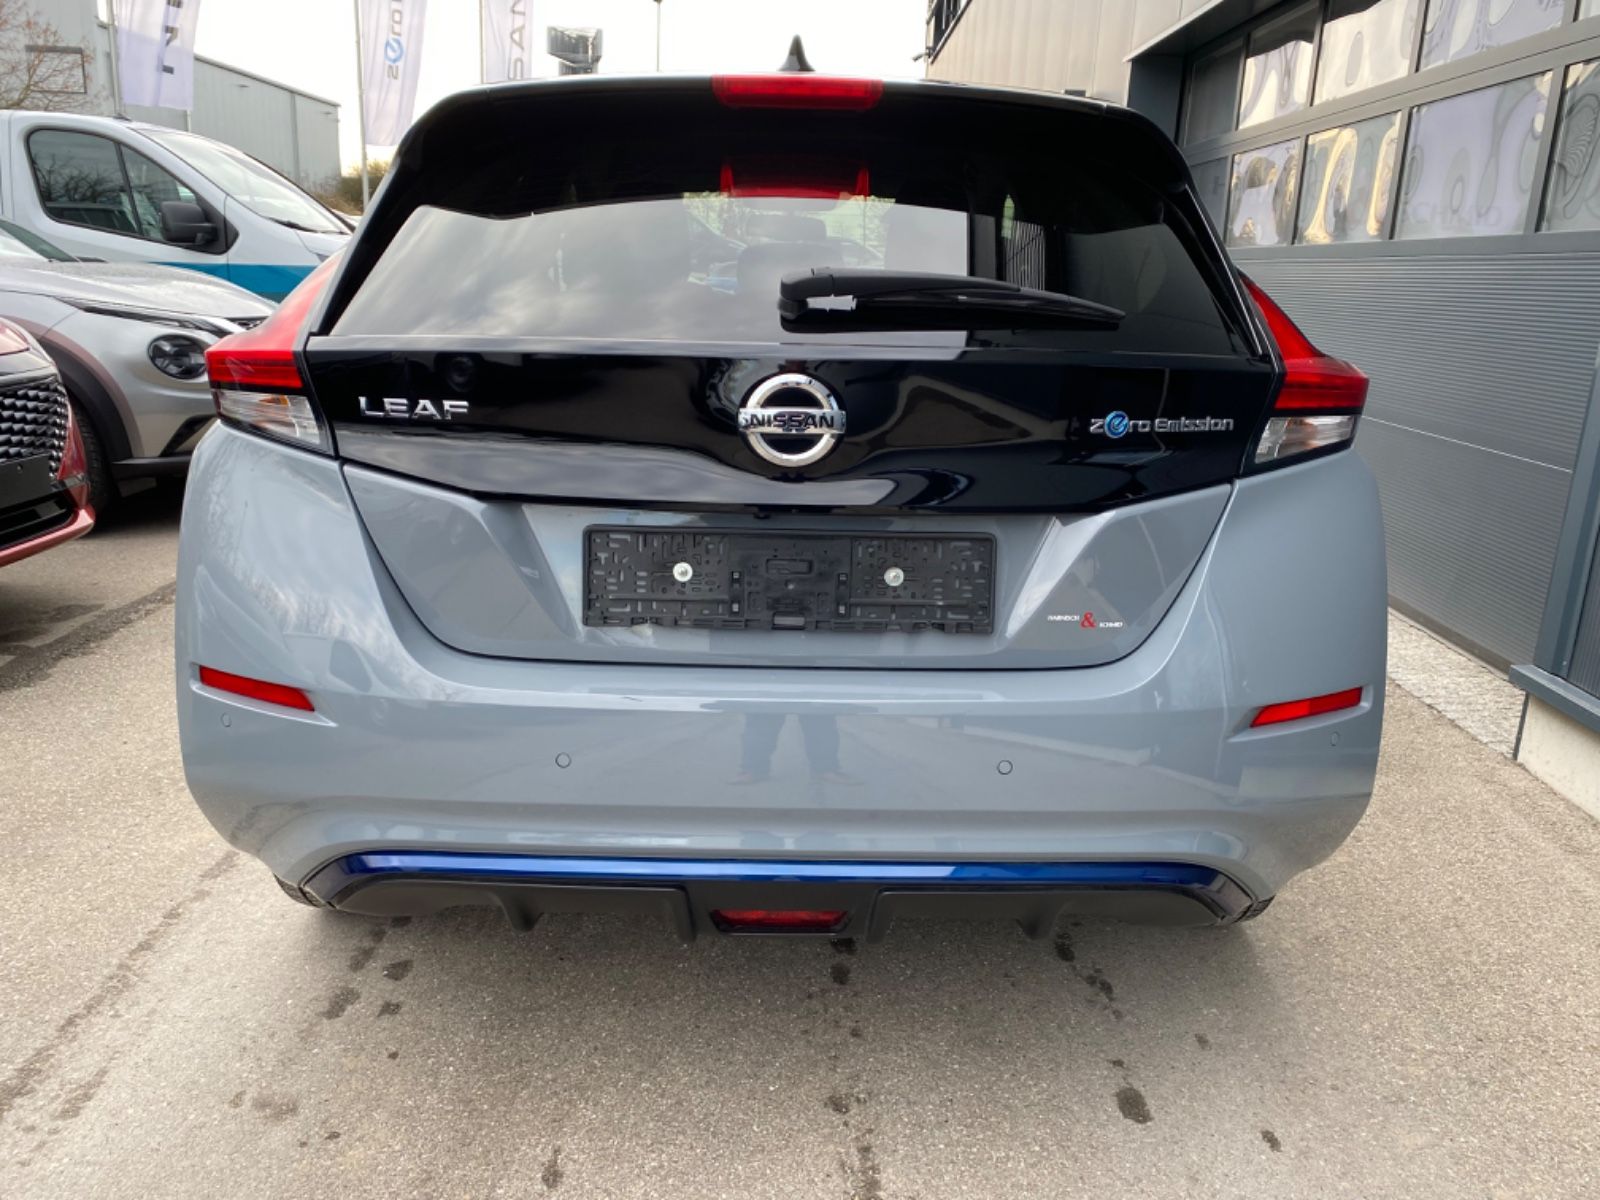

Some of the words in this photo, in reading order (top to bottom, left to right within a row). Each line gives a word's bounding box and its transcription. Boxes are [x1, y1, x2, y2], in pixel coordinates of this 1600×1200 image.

[358, 396, 469, 420] LEAF
[749, 413, 835, 430] NISSAN
[1154, 416, 1234, 433] Emission
